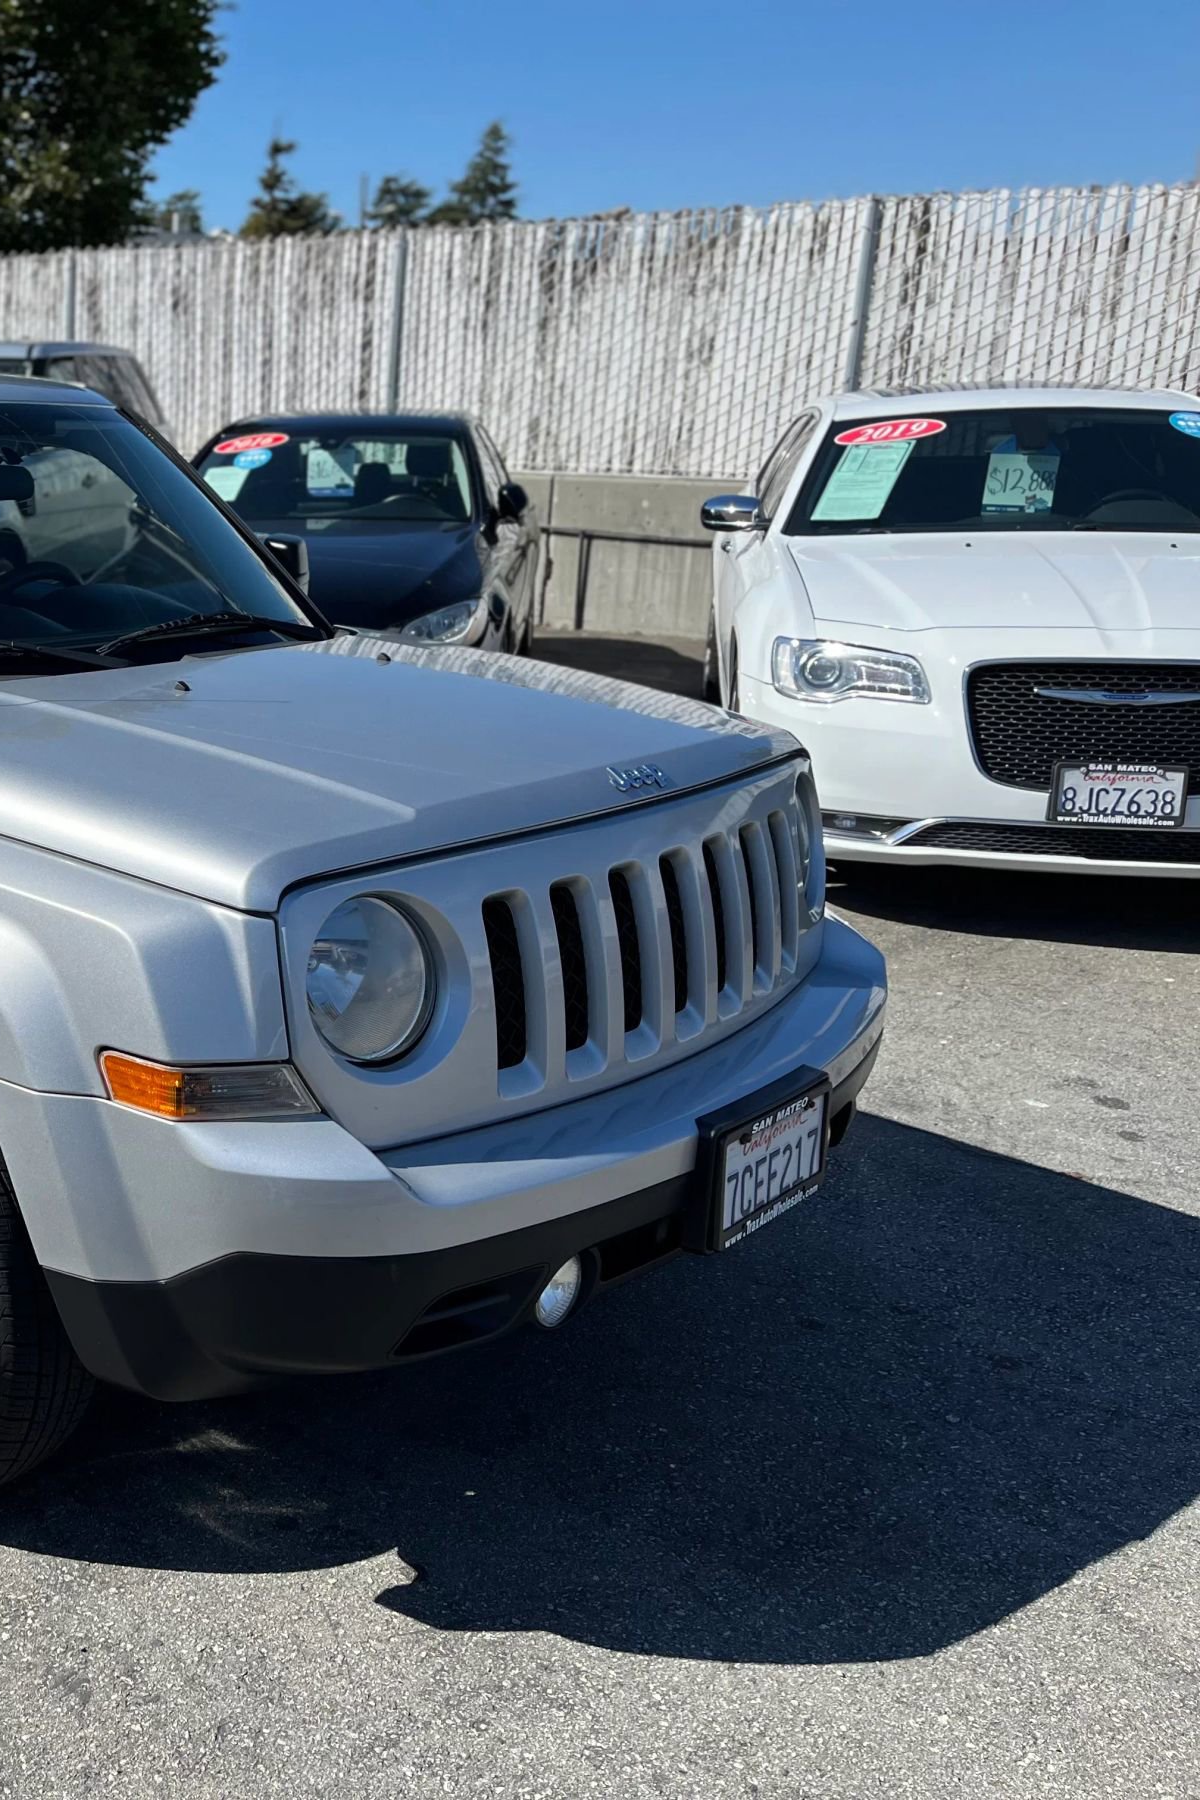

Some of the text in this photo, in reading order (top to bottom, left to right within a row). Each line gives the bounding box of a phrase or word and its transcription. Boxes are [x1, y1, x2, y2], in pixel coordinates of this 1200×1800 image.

[852, 420, 930, 443] 2019
[606, 764, 667, 792] Jeep
[1083, 771, 1162, 786] California
[1088, 763, 1157, 773] SAN MATEO
[1061, 786, 1176, 816] 8JCZ638
[751, 1096, 809, 1134] SAN MATEO
[743, 1114, 808, 1157] California
[727, 1127, 819, 1226] 7CEF217
